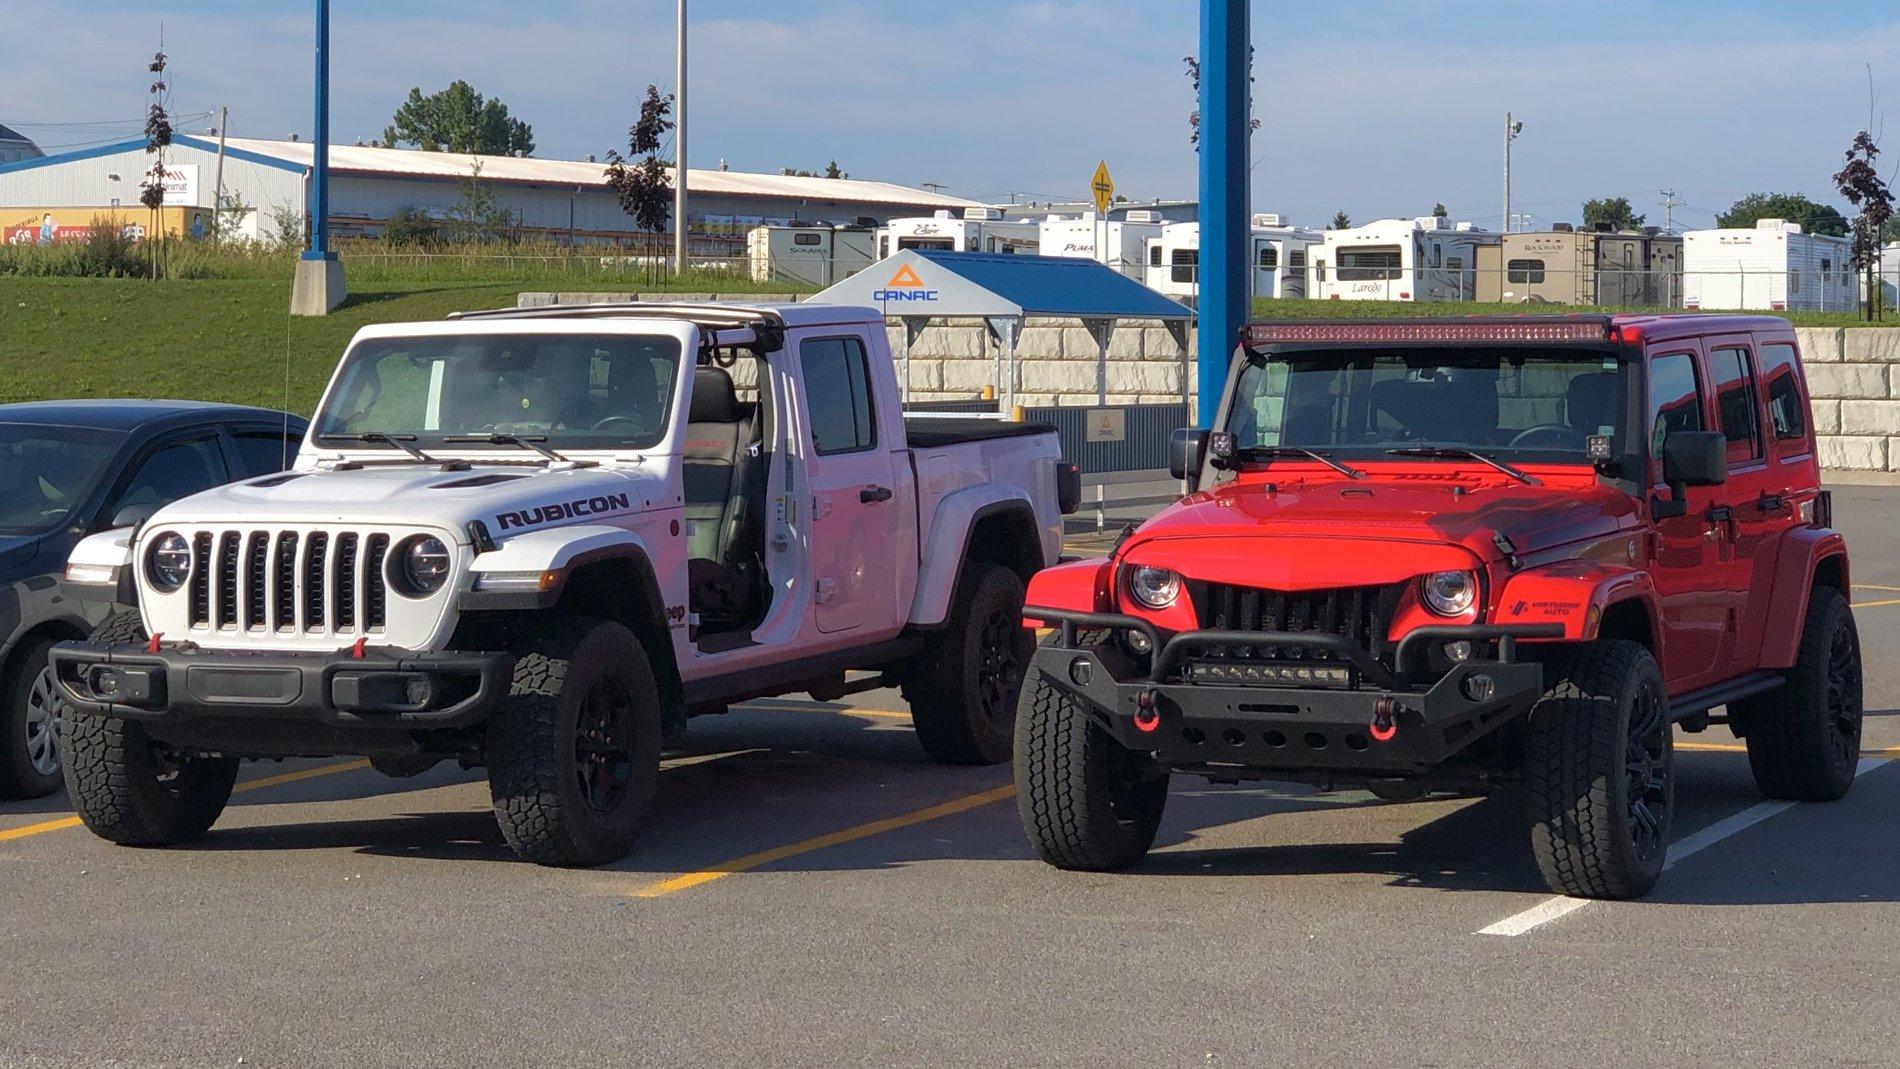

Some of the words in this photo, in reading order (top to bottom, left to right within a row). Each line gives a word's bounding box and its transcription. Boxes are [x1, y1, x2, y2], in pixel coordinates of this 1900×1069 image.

[1064, 243, 1094, 252] PUMA
[1352, 282, 1382, 293] Laredo
[873, 290, 938, 302] CANAC
[496, 493, 630, 530] RUBICON
